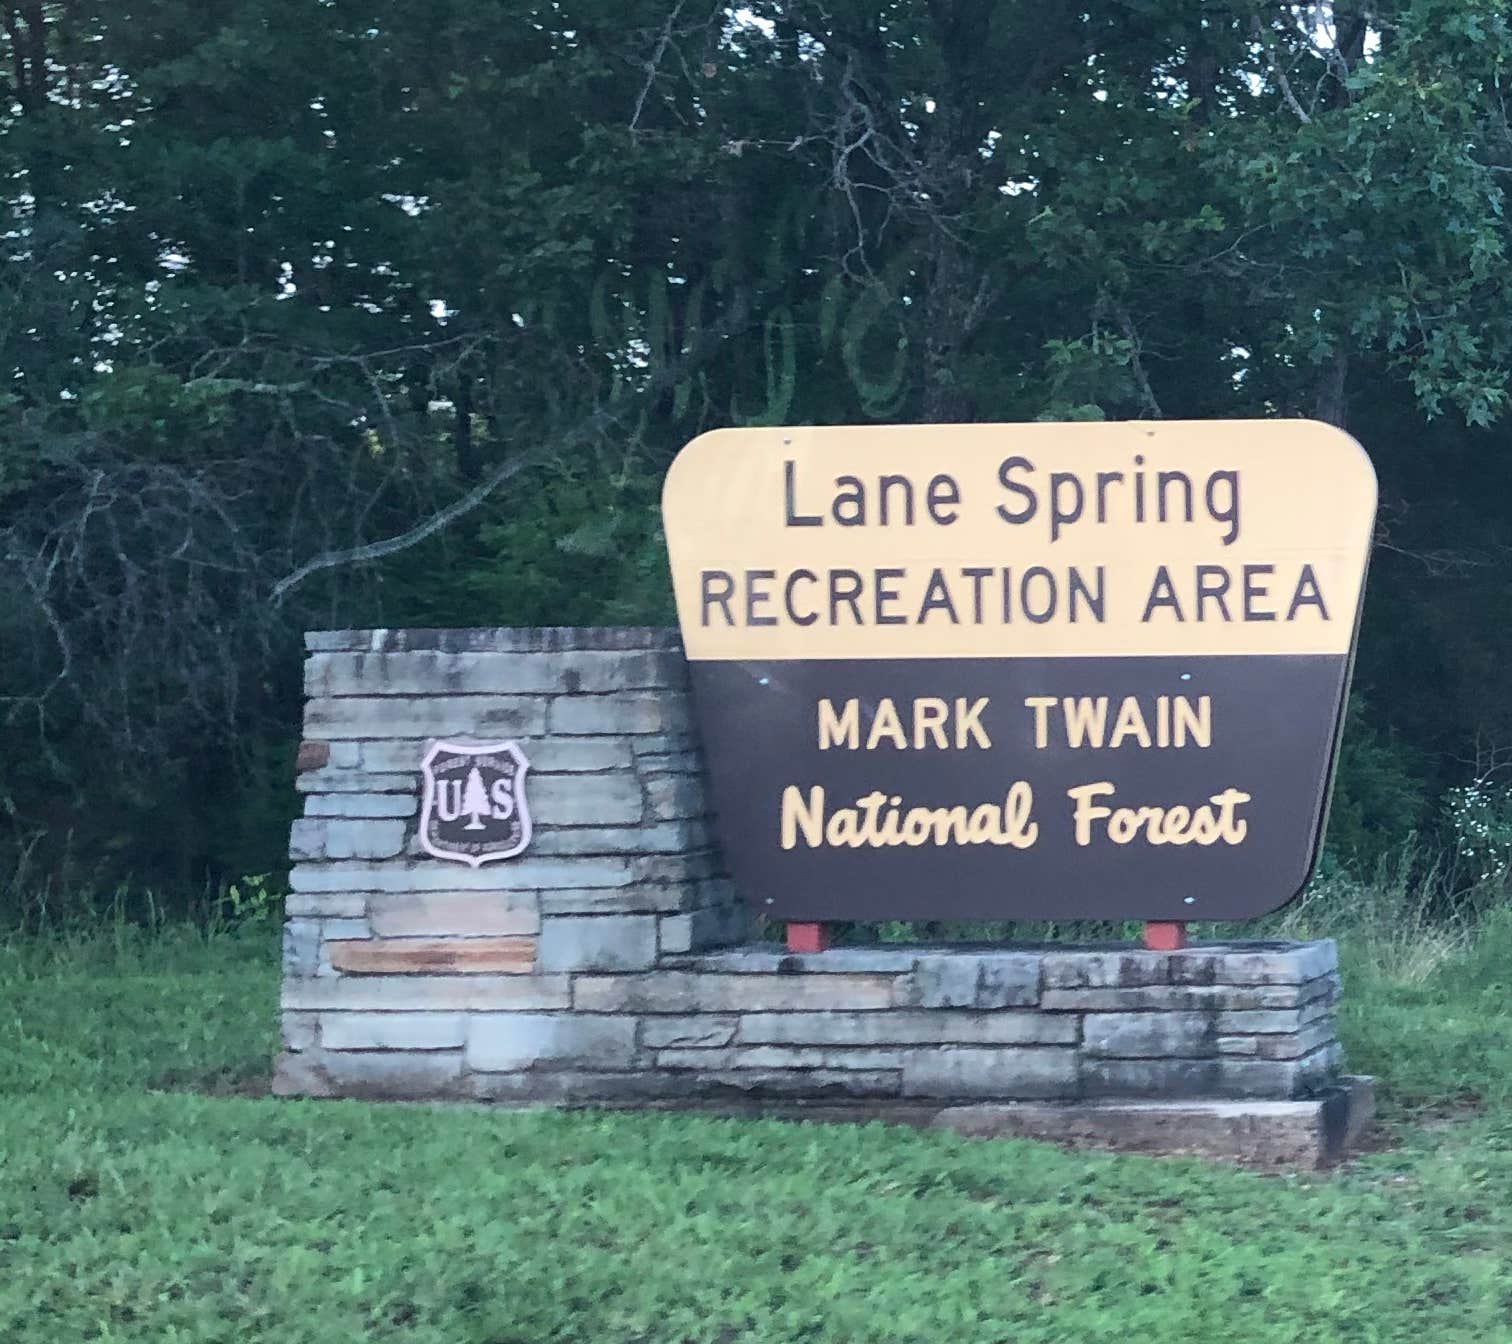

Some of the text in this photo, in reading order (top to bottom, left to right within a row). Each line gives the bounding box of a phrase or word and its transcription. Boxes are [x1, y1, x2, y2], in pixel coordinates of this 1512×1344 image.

[784, 454, 1242, 545] Lane Spring
[701, 563, 1333, 628] RECREATION AREA
[817, 694, 1213, 751] MARK TWAIN
[780, 780, 1252, 850] National Forest
